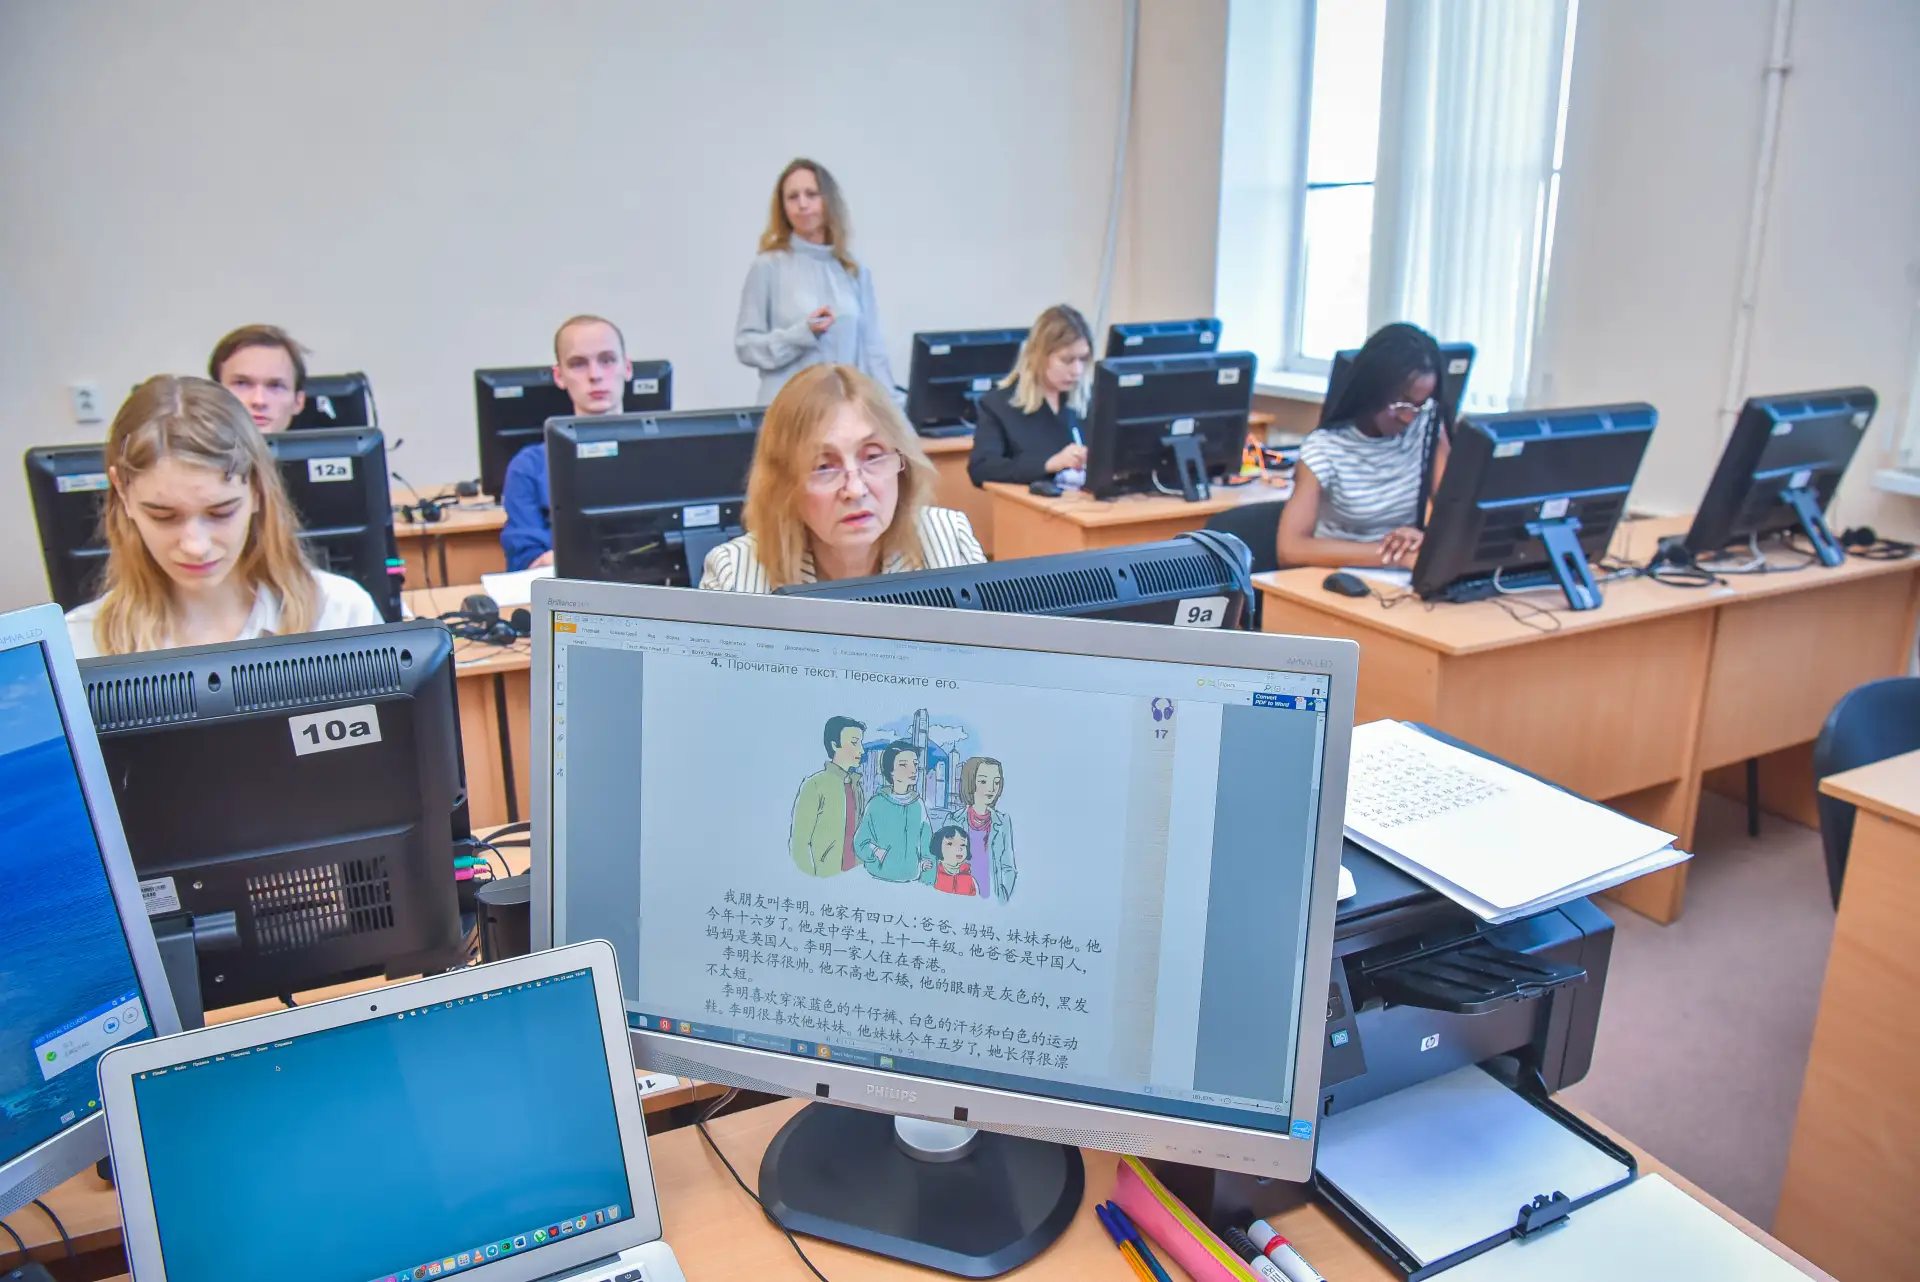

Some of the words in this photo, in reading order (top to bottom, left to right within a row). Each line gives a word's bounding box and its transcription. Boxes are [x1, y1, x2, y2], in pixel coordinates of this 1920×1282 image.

[315, 464, 347, 475] 12a
[547, 598, 577, 607] Brilliance
[1187, 606, 1213, 623] 9a
[25, 628, 43, 638] LED
[1286, 657, 1312, 667] AMVA
[1315, 659, 1333, 668] LED
[710, 657, 722, 668] 4.
[728, 659, 798, 675] Прочитайте
[804, 667, 838, 679] текст.
[844, 669, 929, 687] Перескажите
[935, 679, 960, 690] его.
[1255, 693, 1278, 701] Convert
[302, 720, 371, 745] 10a
[1154, 729, 1169, 739] 17
[706, 963, 753, 982] 不太短。
[866, 1084, 917, 1103] PHILIPS
